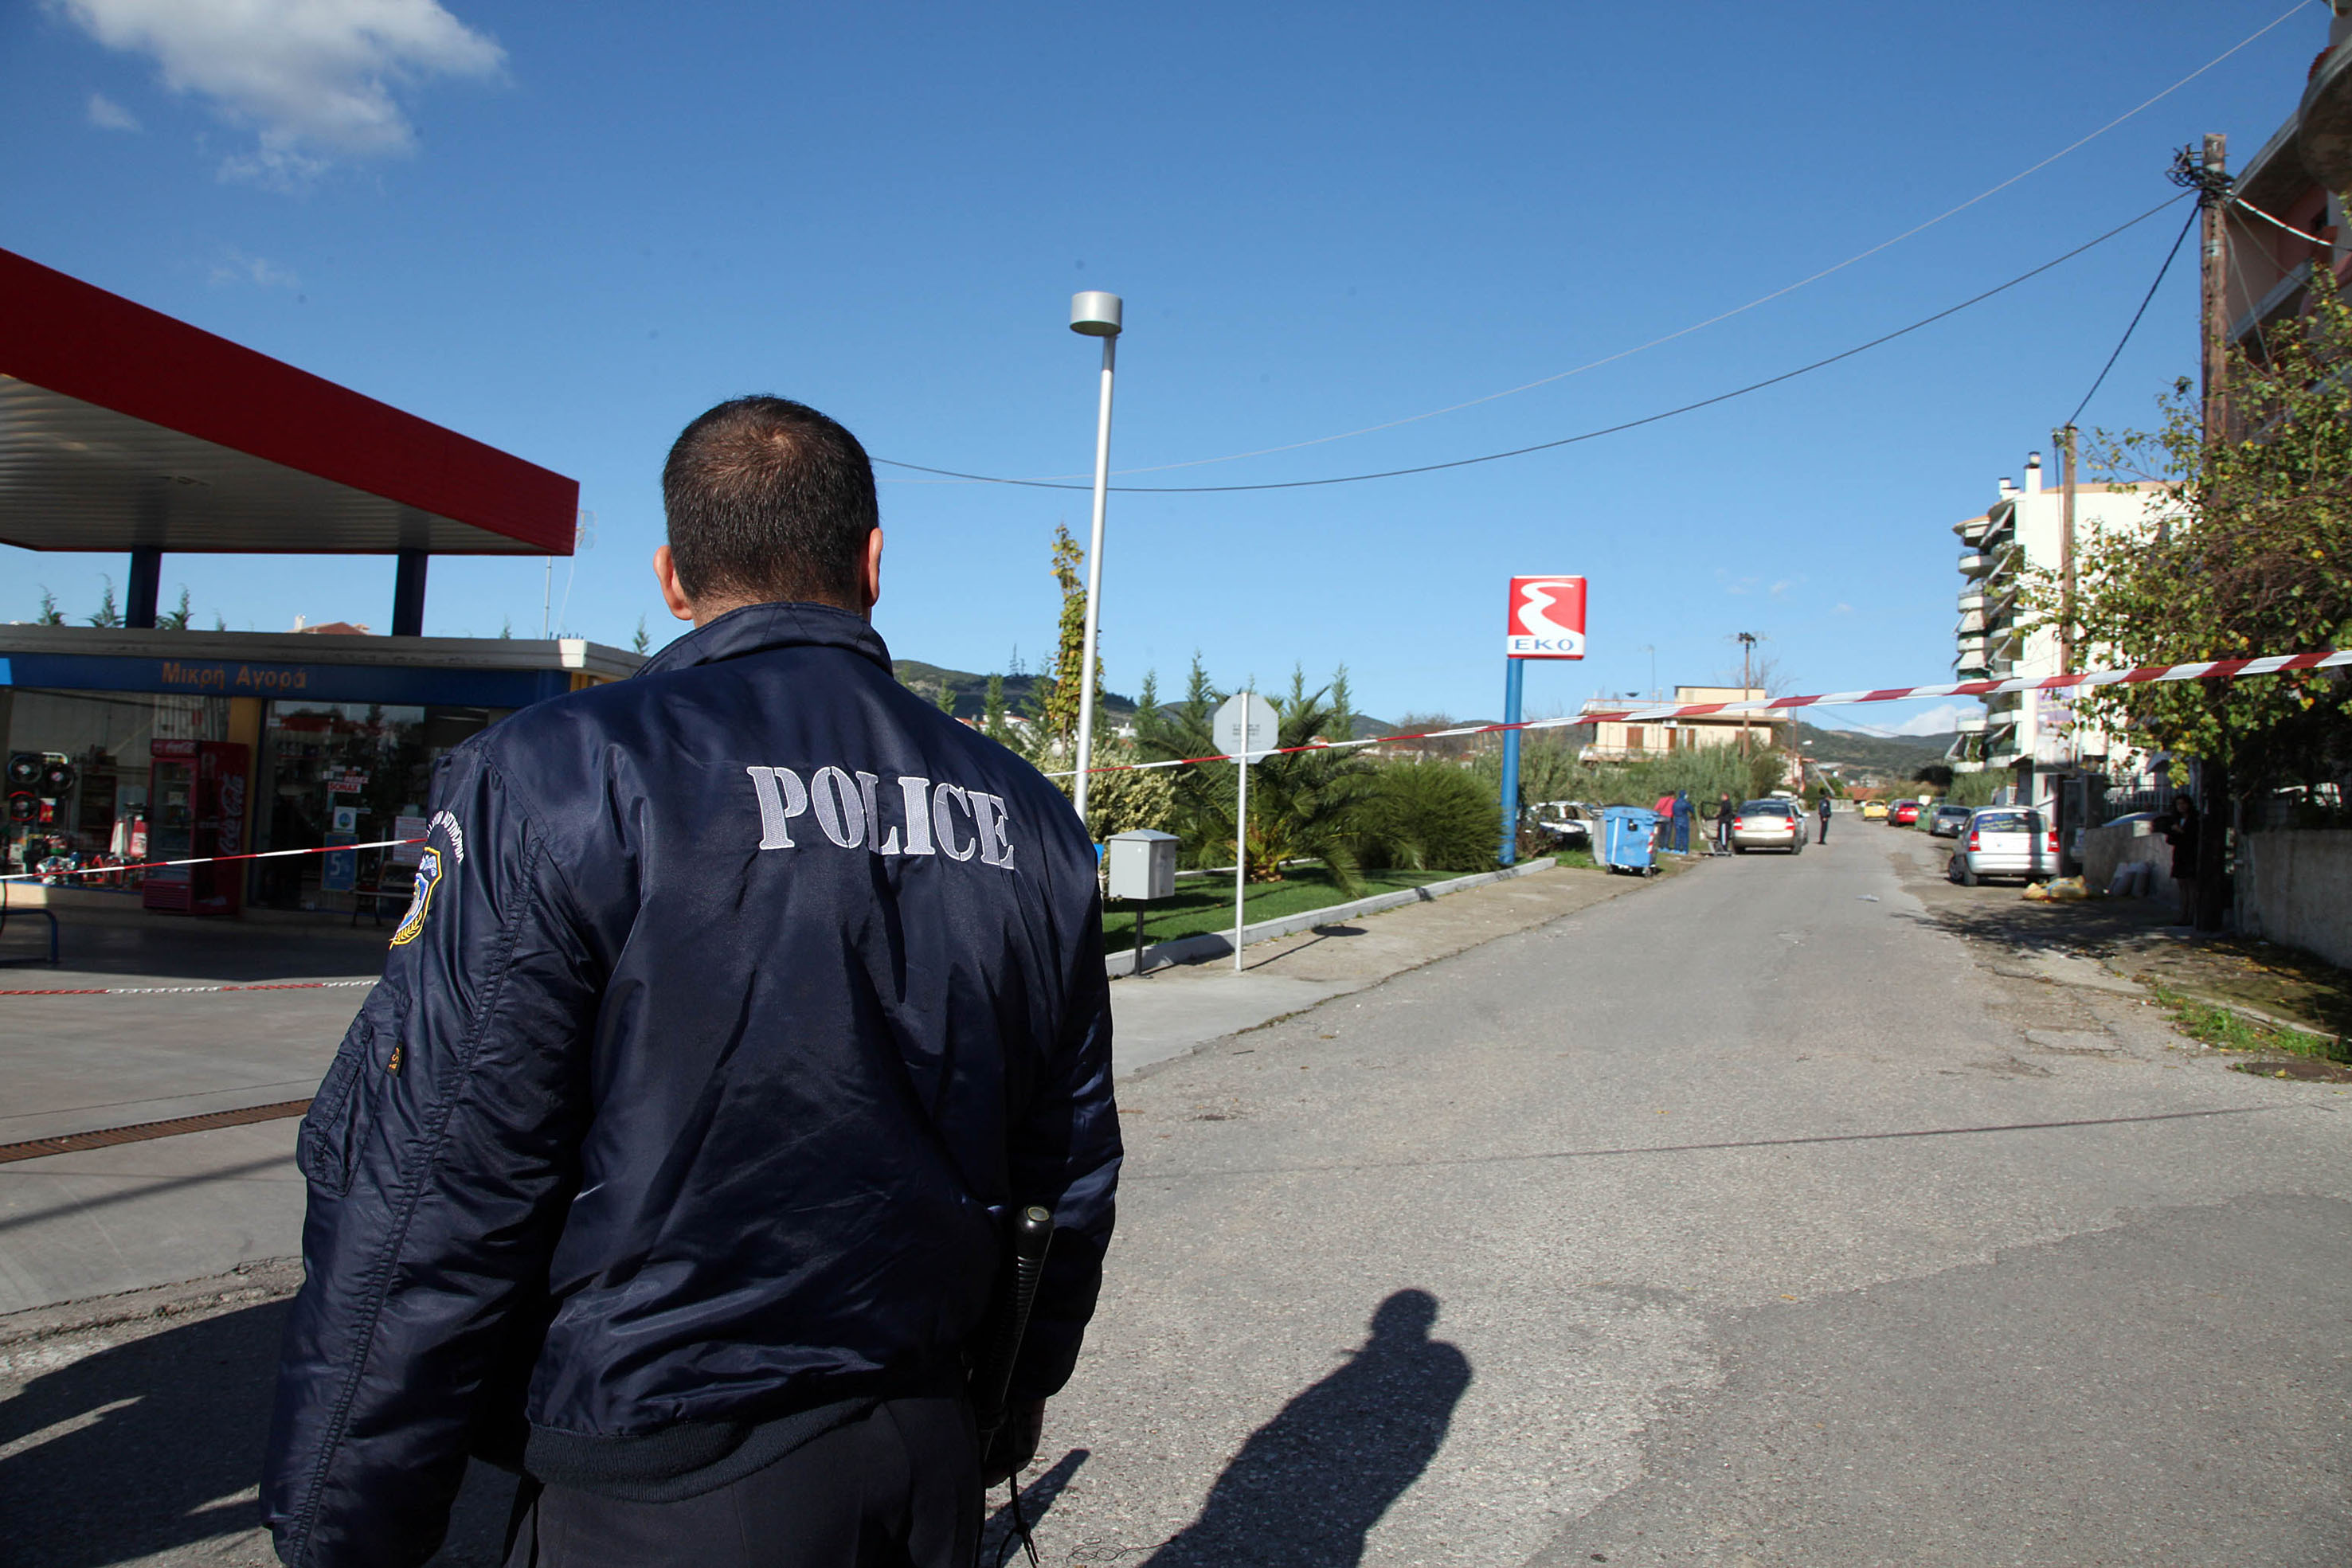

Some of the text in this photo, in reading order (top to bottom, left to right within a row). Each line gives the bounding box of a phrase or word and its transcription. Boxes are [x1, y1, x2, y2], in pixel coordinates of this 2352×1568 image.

[1515, 639, 1574, 651] EKO
[162, 662, 307, 691] Μικρή Αγορά
[746, 766, 1015, 870] POLICE
